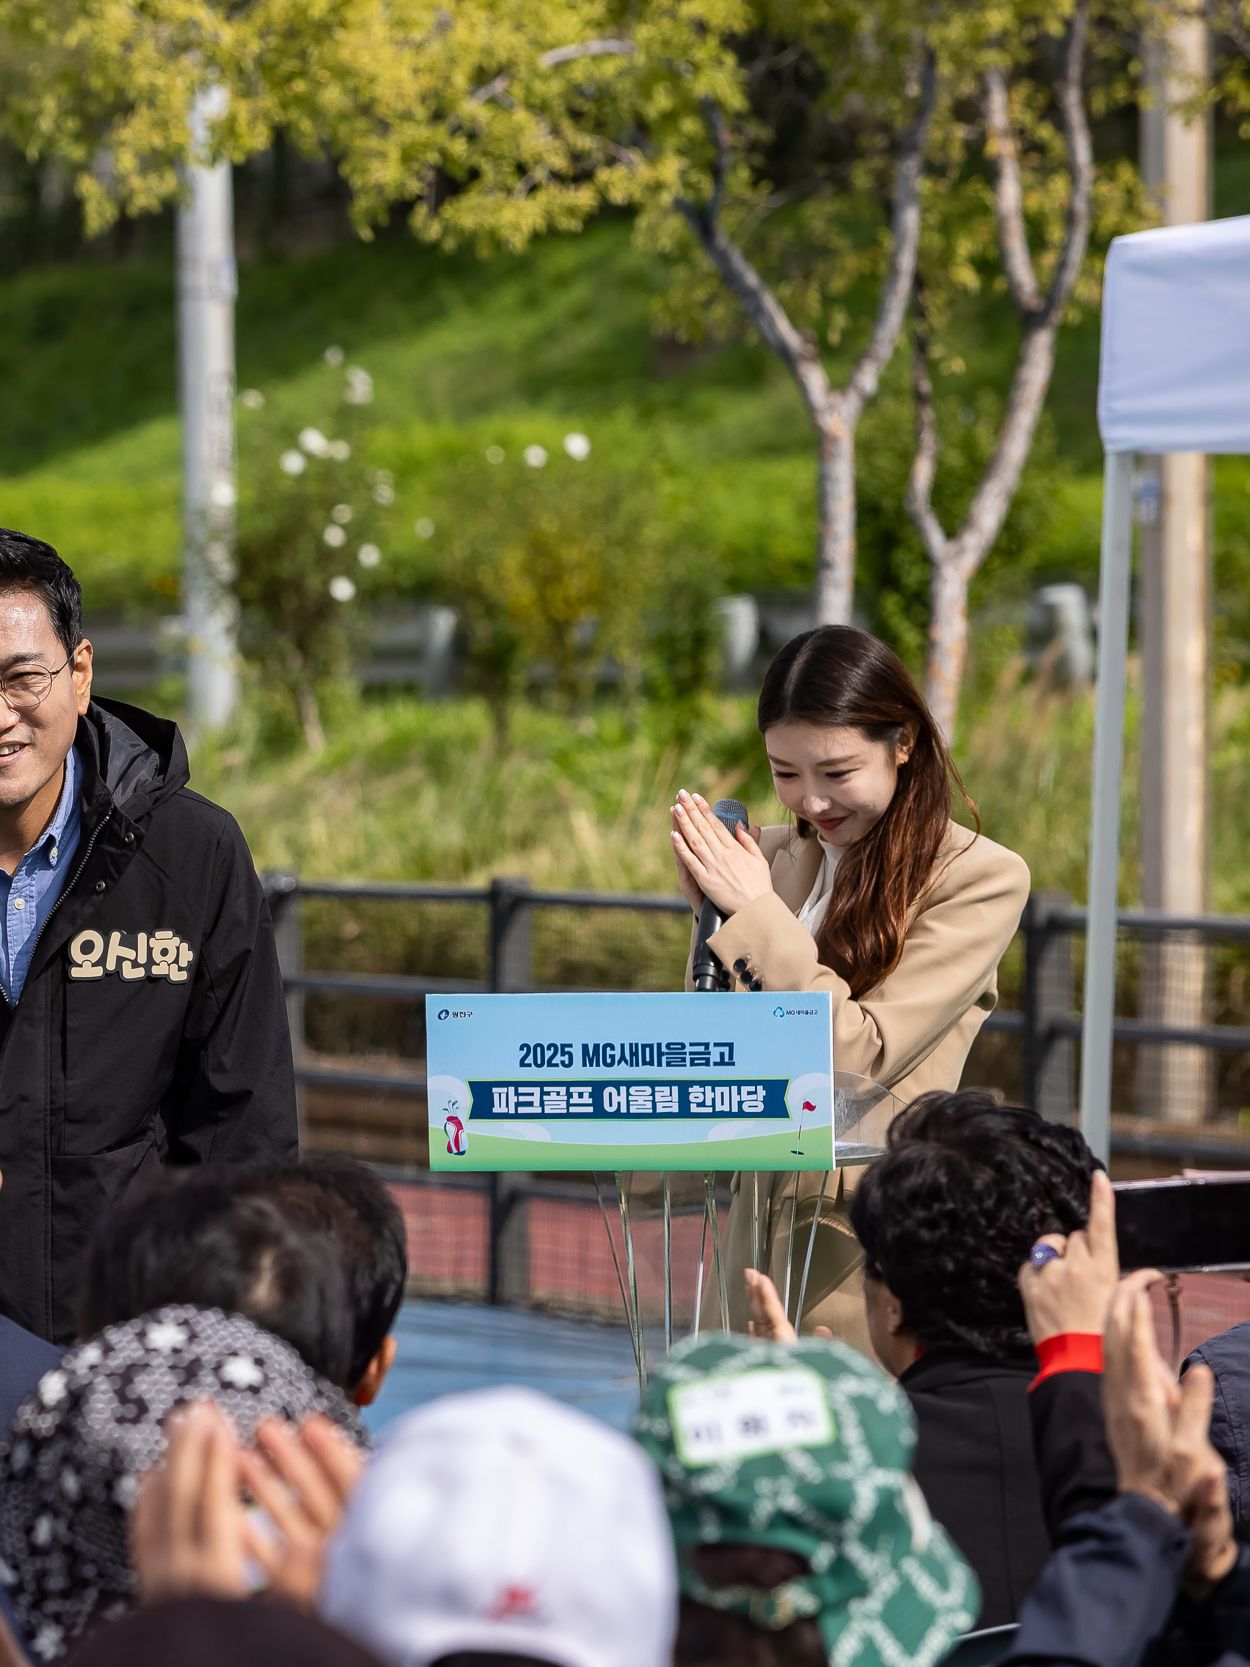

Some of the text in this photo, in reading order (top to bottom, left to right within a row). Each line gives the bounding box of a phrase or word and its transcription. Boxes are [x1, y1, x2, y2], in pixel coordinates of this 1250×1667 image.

[70, 929, 194, 982] 오신환
[519, 1042, 736, 1068] 2025 MG새마을금고
[492, 1085, 766, 1114] 파크골프 어울림 한마당
